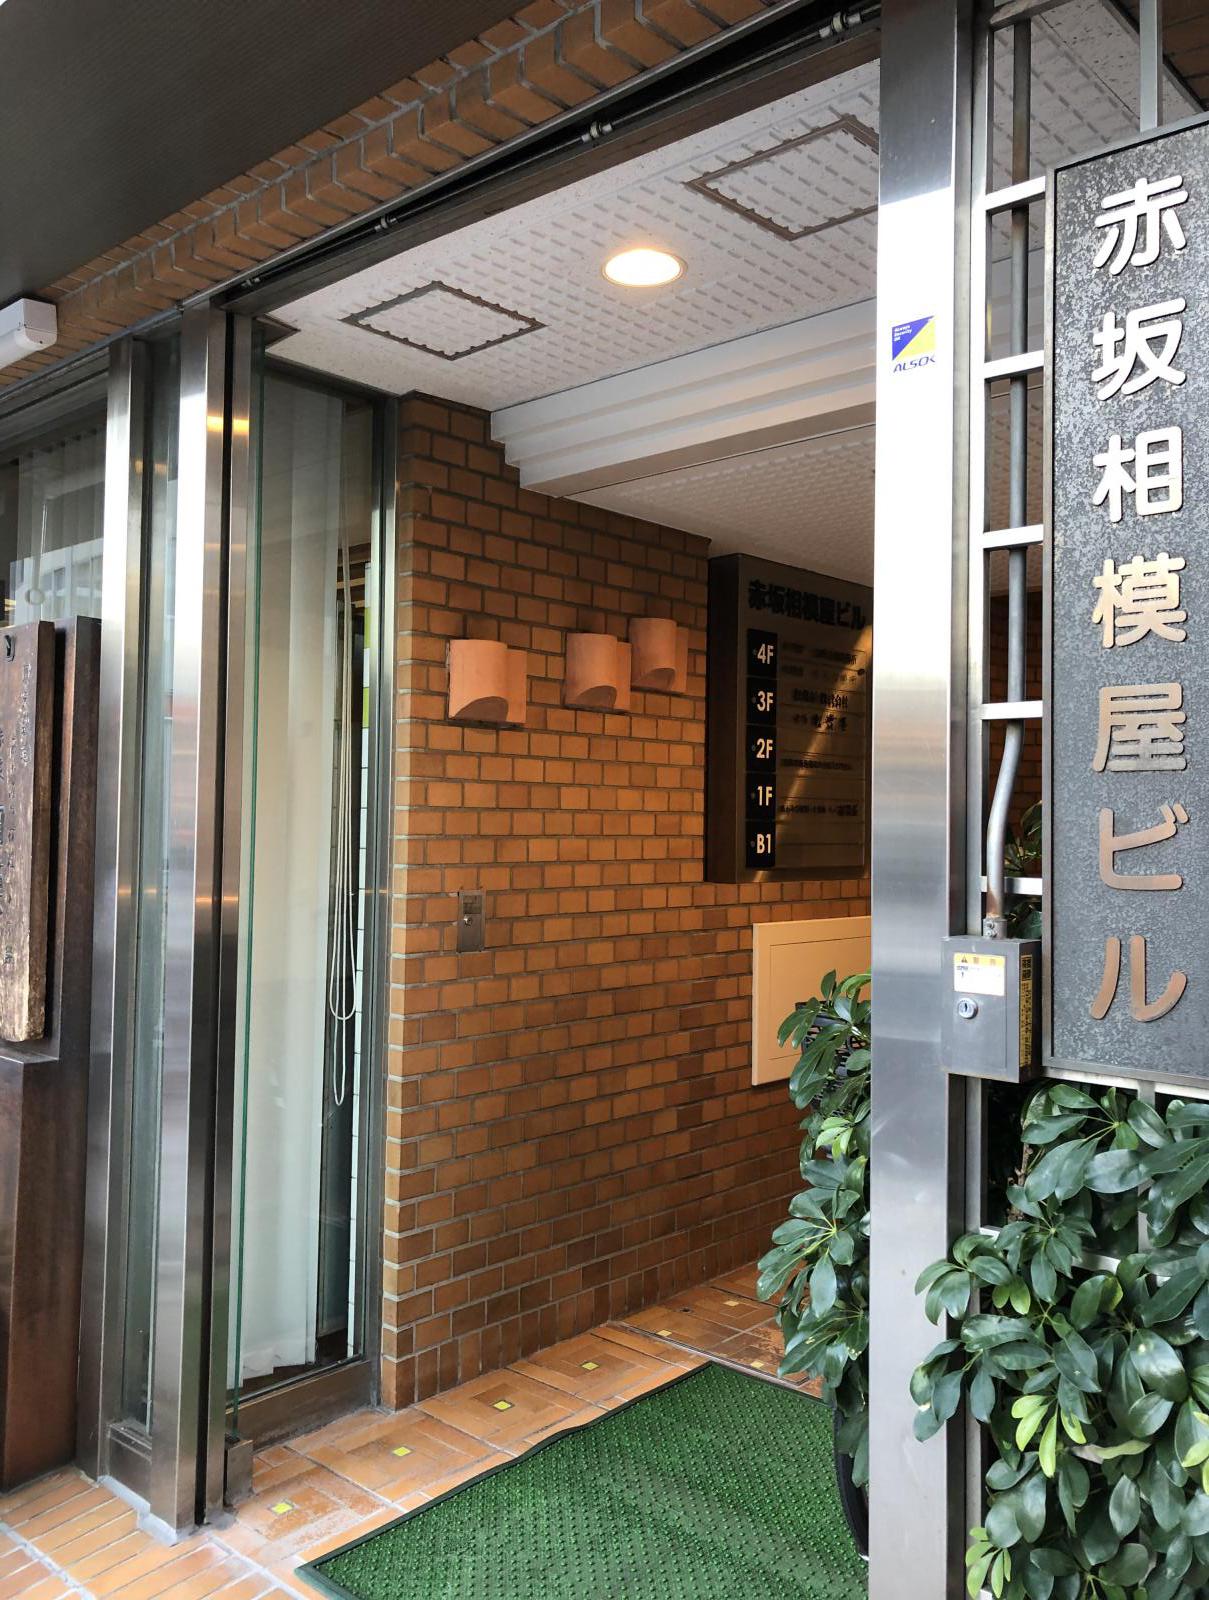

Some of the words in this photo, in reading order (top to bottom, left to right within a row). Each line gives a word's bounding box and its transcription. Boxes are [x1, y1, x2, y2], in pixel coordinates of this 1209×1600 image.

[893, 353, 936, 373] ALSOK
[748, 579, 865, 630] 赤坂相模屋ビル
[1091, 175, 1188, 1023] 赤坂相模屋ビル
[757, 643, 774, 665] 4F
[756, 691, 774, 713] 3F
[756, 738, 773, 759] 2F
[757, 785, 773, 806] 1F
[756, 833, 772, 854] B1
